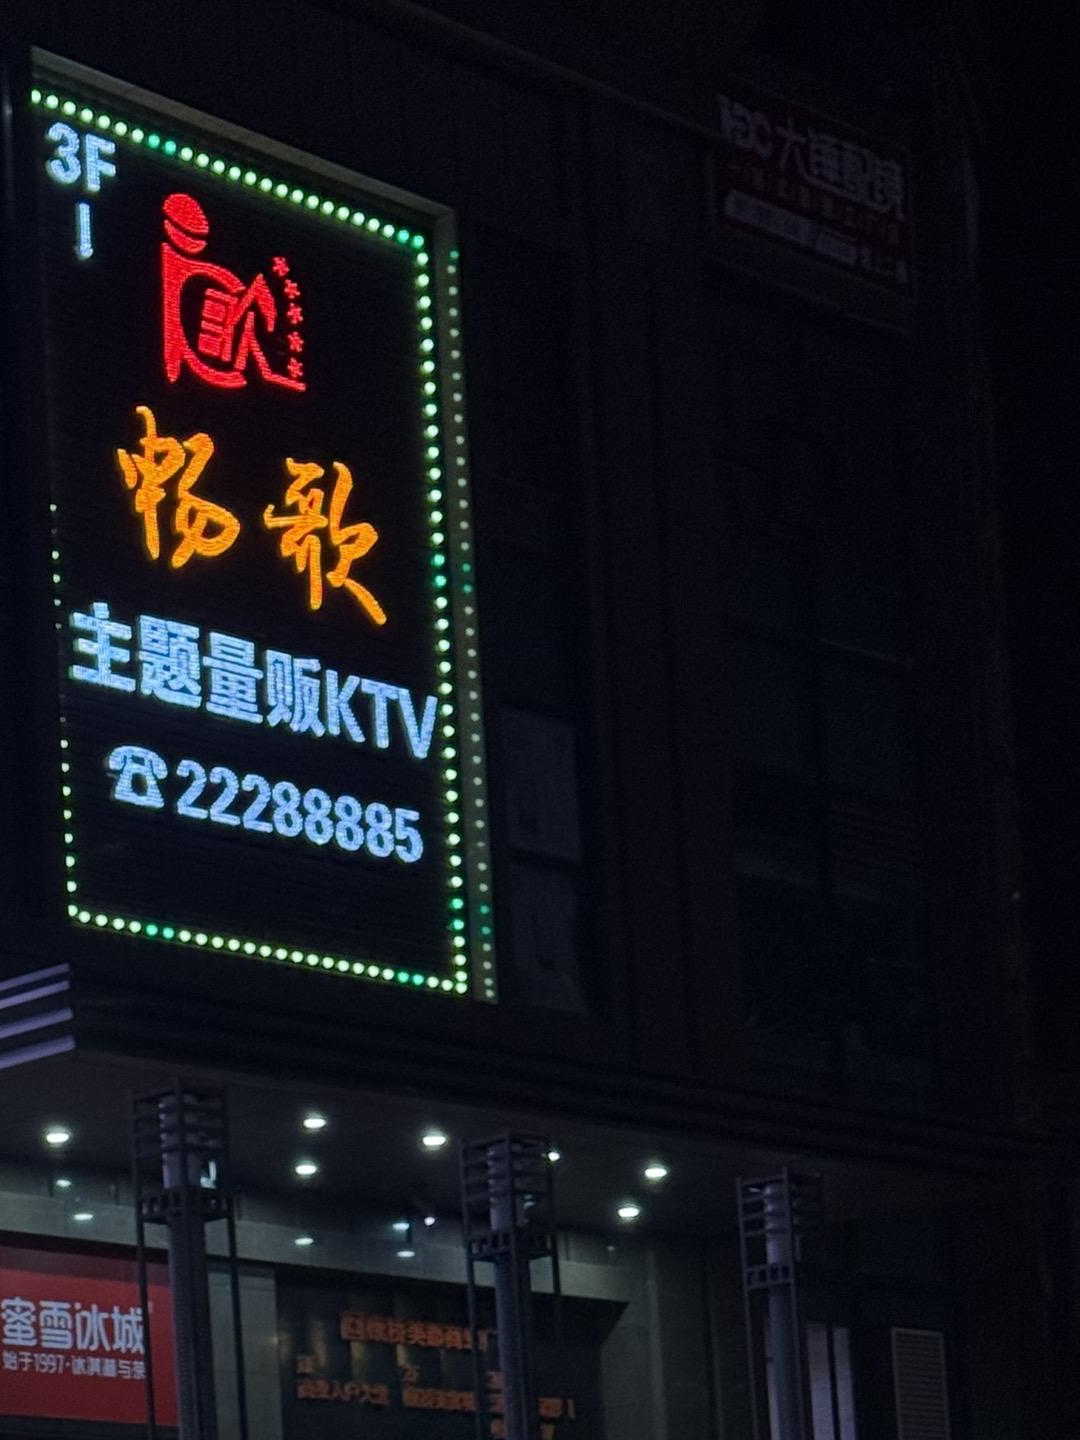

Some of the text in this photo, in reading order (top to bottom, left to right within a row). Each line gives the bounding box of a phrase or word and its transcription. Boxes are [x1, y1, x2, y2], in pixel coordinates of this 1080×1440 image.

[46, 122, 117, 192] 3F
[116, 404, 389, 626] 畅歌
[68, 601, 439, 760] 主题量贩KTV
[175, 758, 424, 864] 22288885
[0, 1296, 146, 1355] 蜜雪冰城
